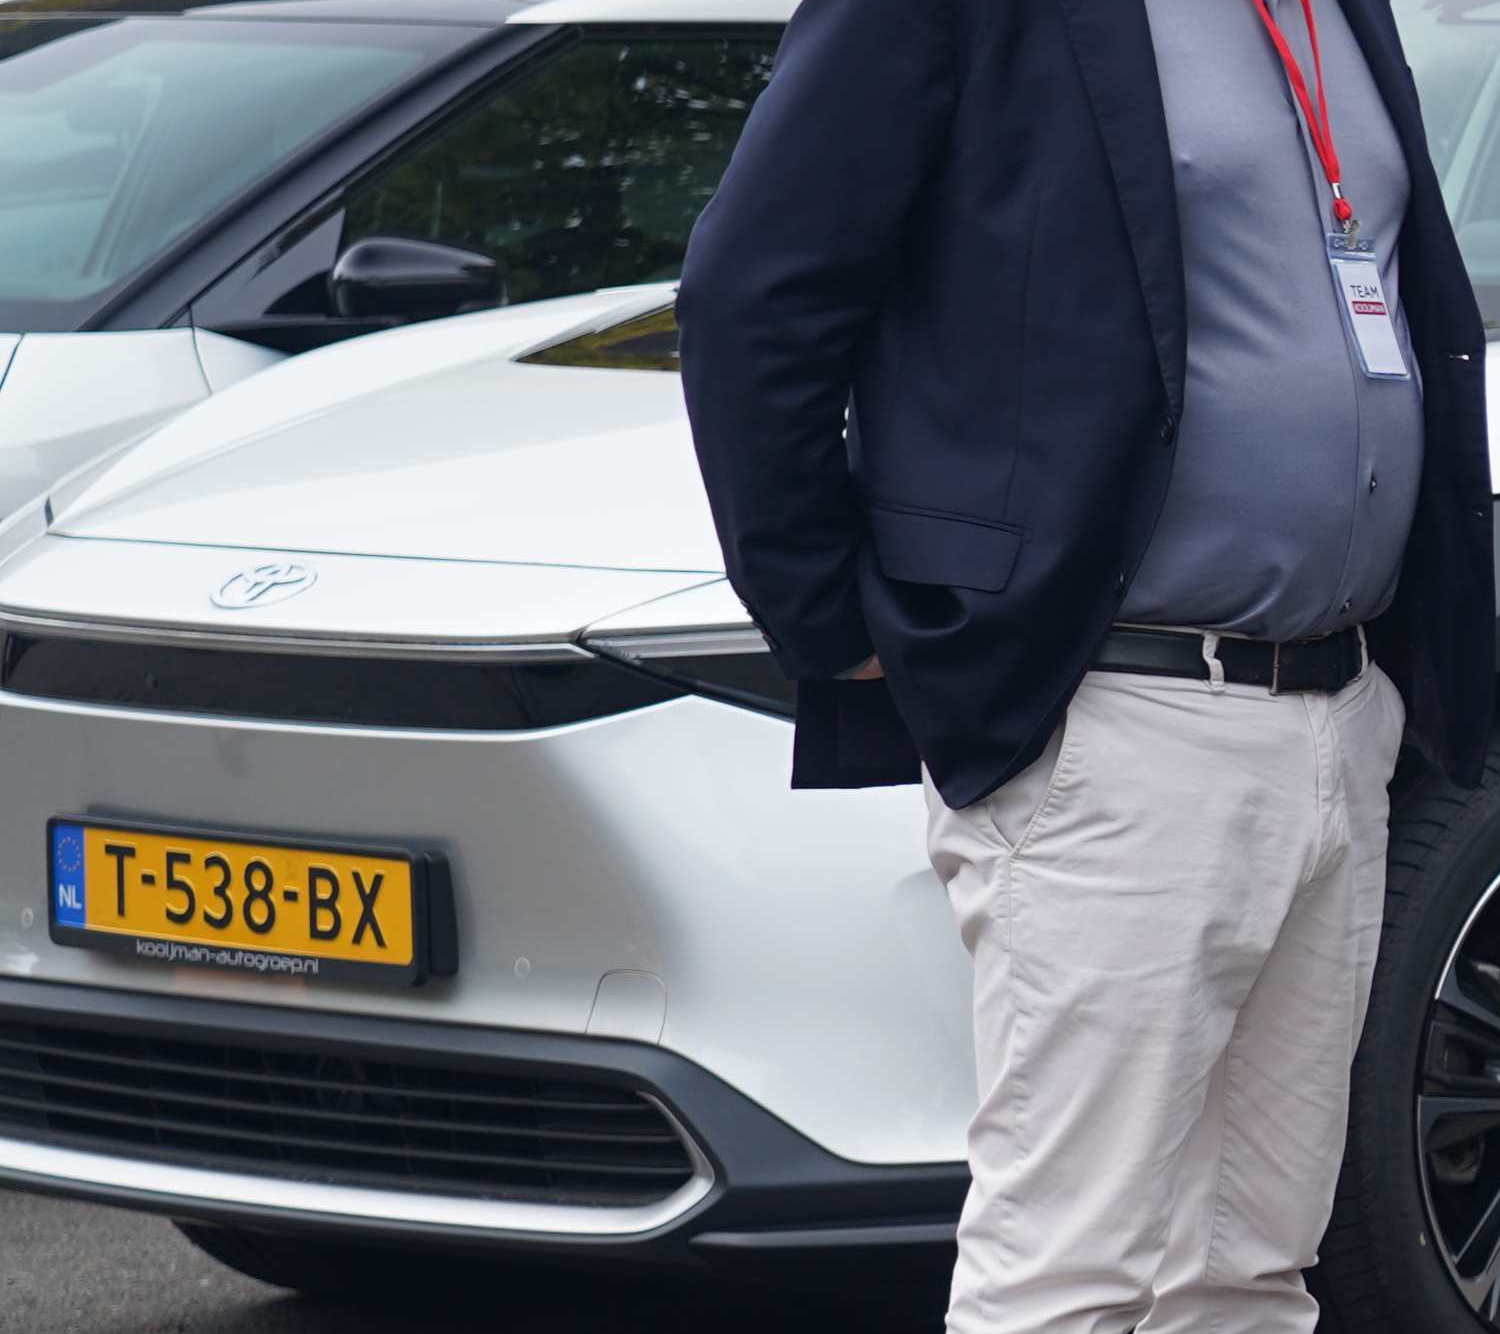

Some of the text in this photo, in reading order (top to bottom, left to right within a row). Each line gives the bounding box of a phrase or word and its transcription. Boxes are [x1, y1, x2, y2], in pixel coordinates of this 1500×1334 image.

[1350, 284, 1380, 299] TEAM
[58, 844, 387, 948] NL T-538-BX
[136, 938, 320, 975] kooijman-autogroep.nl
